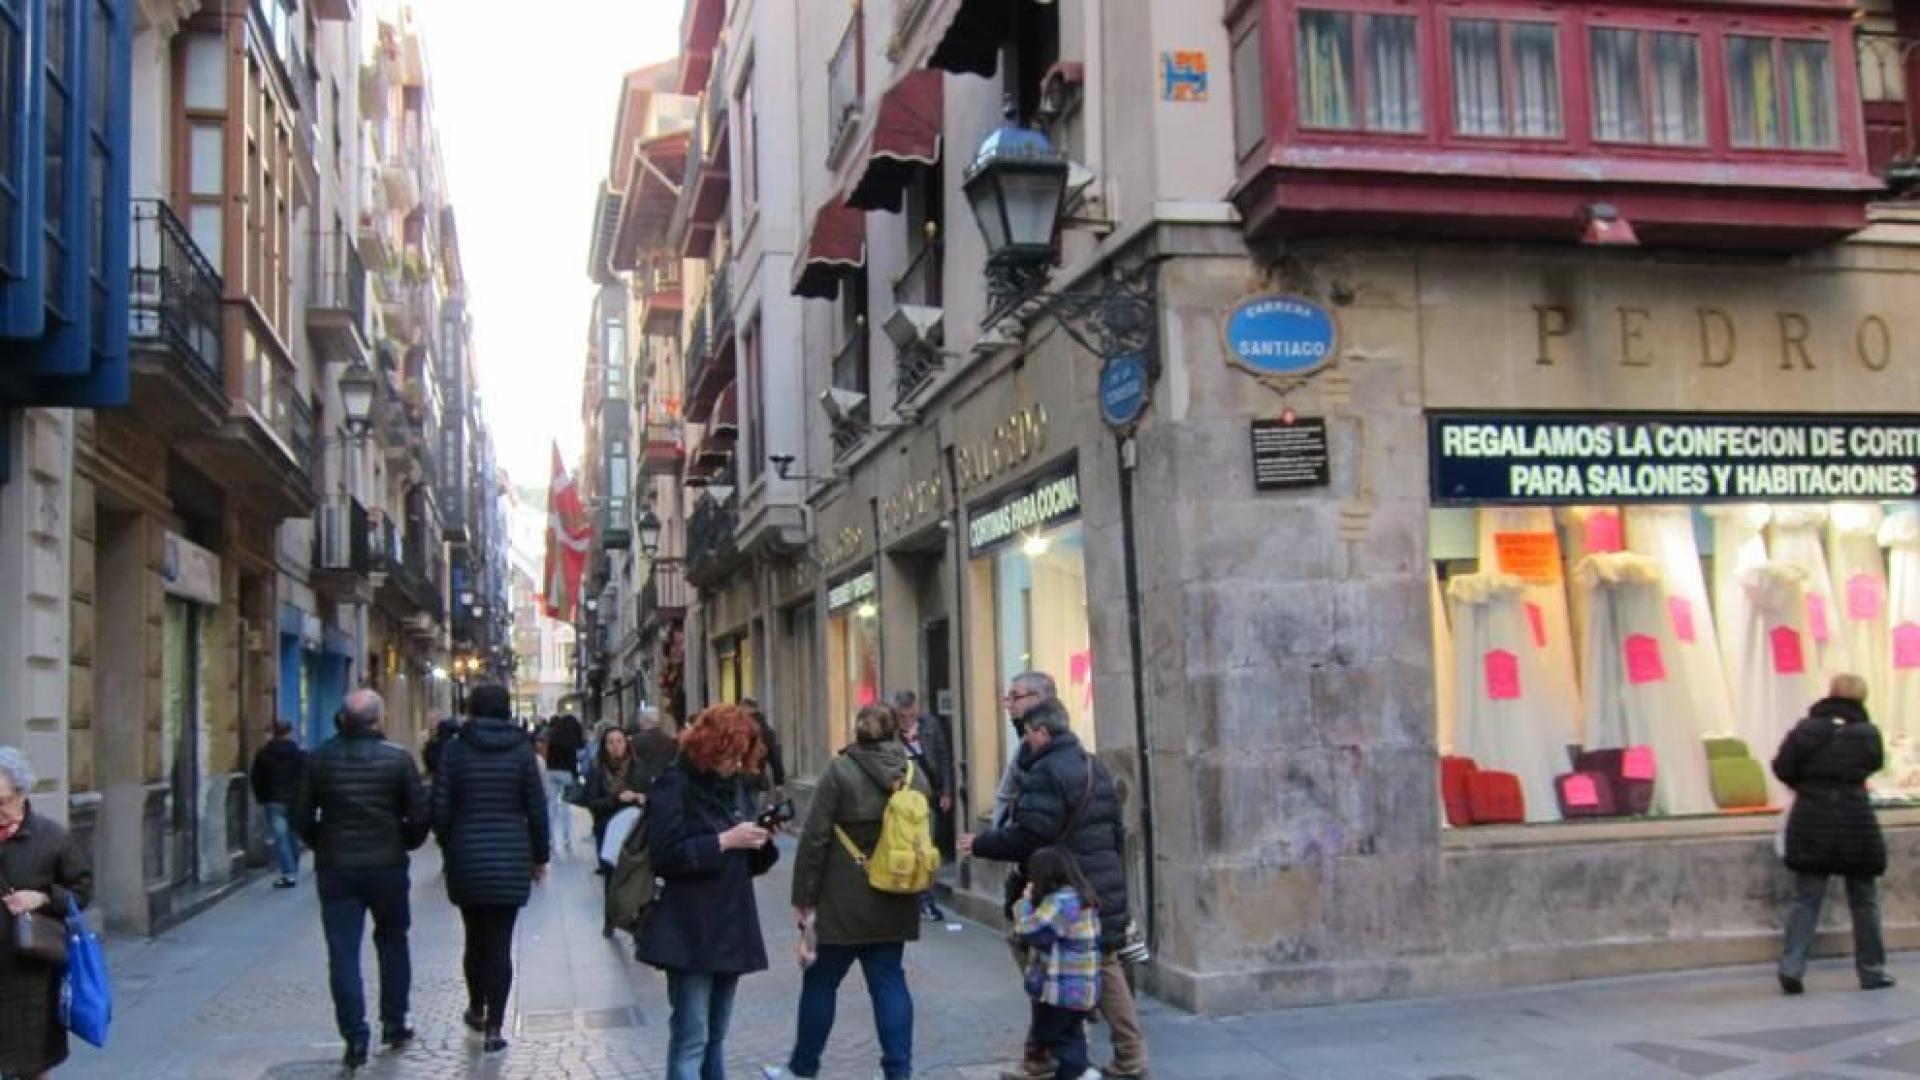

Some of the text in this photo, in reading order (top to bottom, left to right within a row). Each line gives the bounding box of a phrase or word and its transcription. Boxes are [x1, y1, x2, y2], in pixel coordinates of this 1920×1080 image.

[1239, 340, 1325, 357] SANTIAGO
[1533, 304, 1892, 371] PEDRO
[1442, 424, 1613, 457] REGALAMOS
[1616, 425, 1653, 457] LA
[1655, 425, 1806, 457] CONFECION
[1809, 426, 1847, 457] DE
[1510, 464, 1917, 496] PARA SALONES Y HABITACIONES
